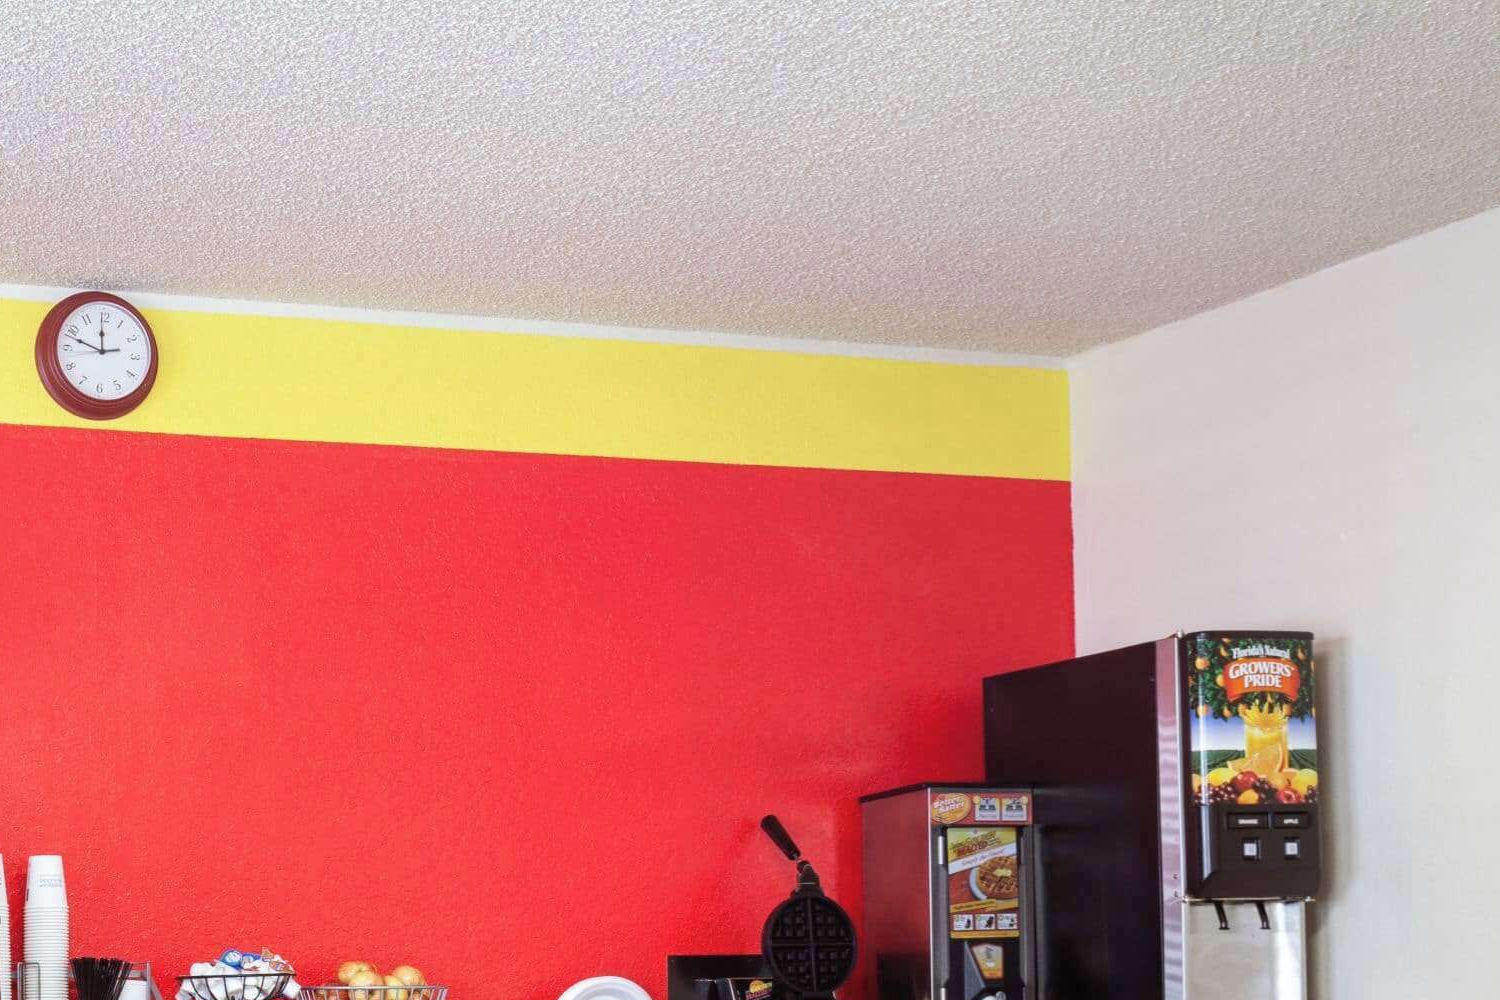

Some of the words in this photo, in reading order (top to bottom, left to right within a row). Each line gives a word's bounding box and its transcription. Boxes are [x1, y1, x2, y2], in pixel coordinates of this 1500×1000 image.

[81, 314, 92, 325] 11
[117, 320, 124, 329] 1
[65, 325, 79, 337] 10
[127, 334, 138, 343] 2
[65, 362, 76, 371] 8
[126, 369, 137, 379] 4
[79, 376, 88, 385] 7
[113, 380, 121, 390] 5
[96, 383, 103, 393] 6
[1243, 674, 1283, 688] PRIDE
